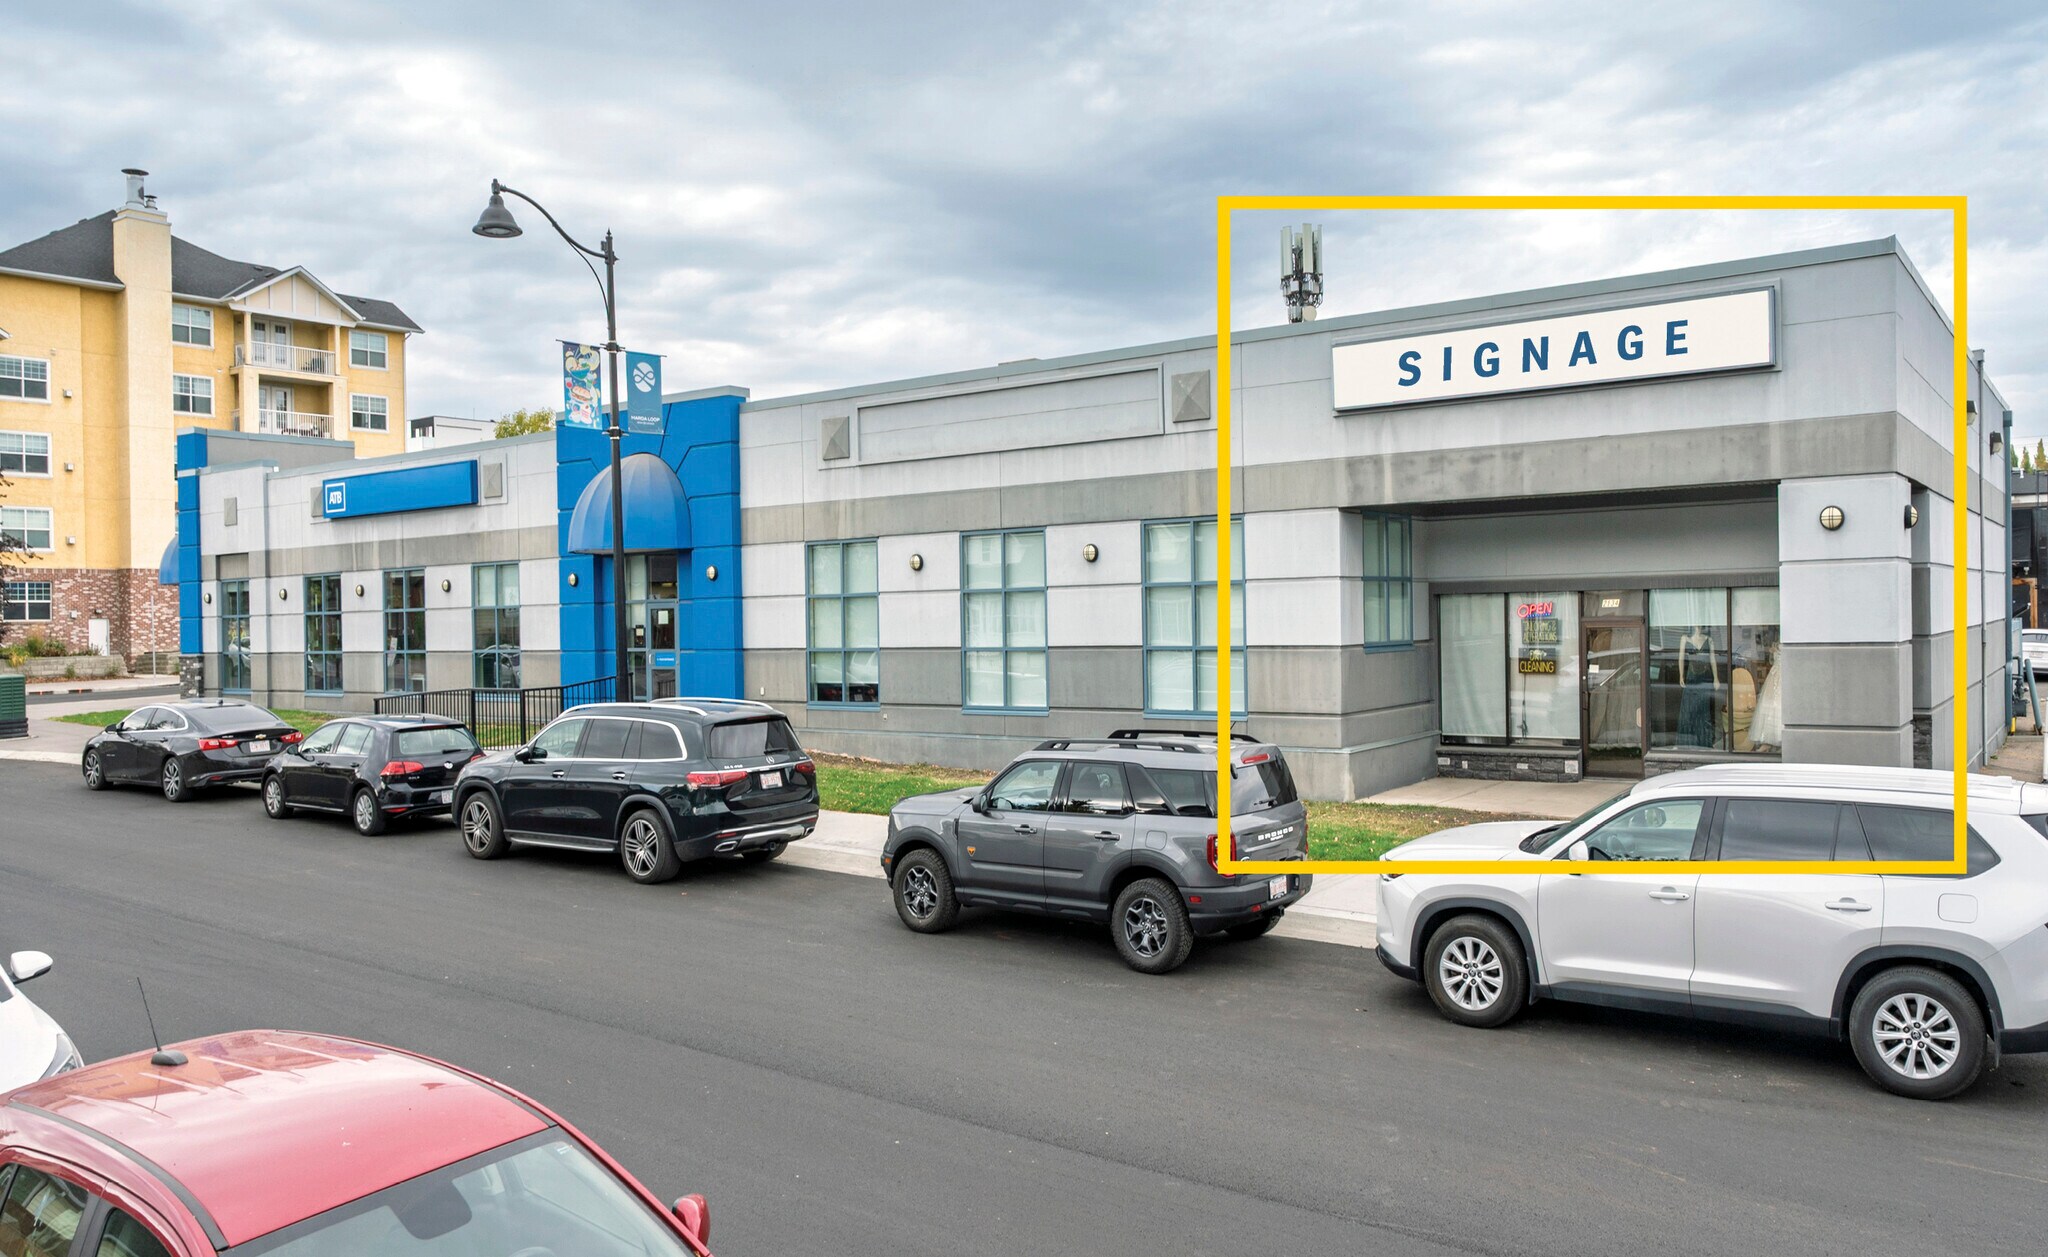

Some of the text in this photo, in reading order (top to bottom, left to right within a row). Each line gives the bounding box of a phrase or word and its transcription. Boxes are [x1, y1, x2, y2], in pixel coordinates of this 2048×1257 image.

[1398, 319, 1688, 386] SIGNAGE
[329, 491, 342, 504] ATB
[1517, 601, 1553, 618] OPEN
[1519, 661, 1554, 673] CLEANING
[1257, 826, 1293, 841] BRONCO
